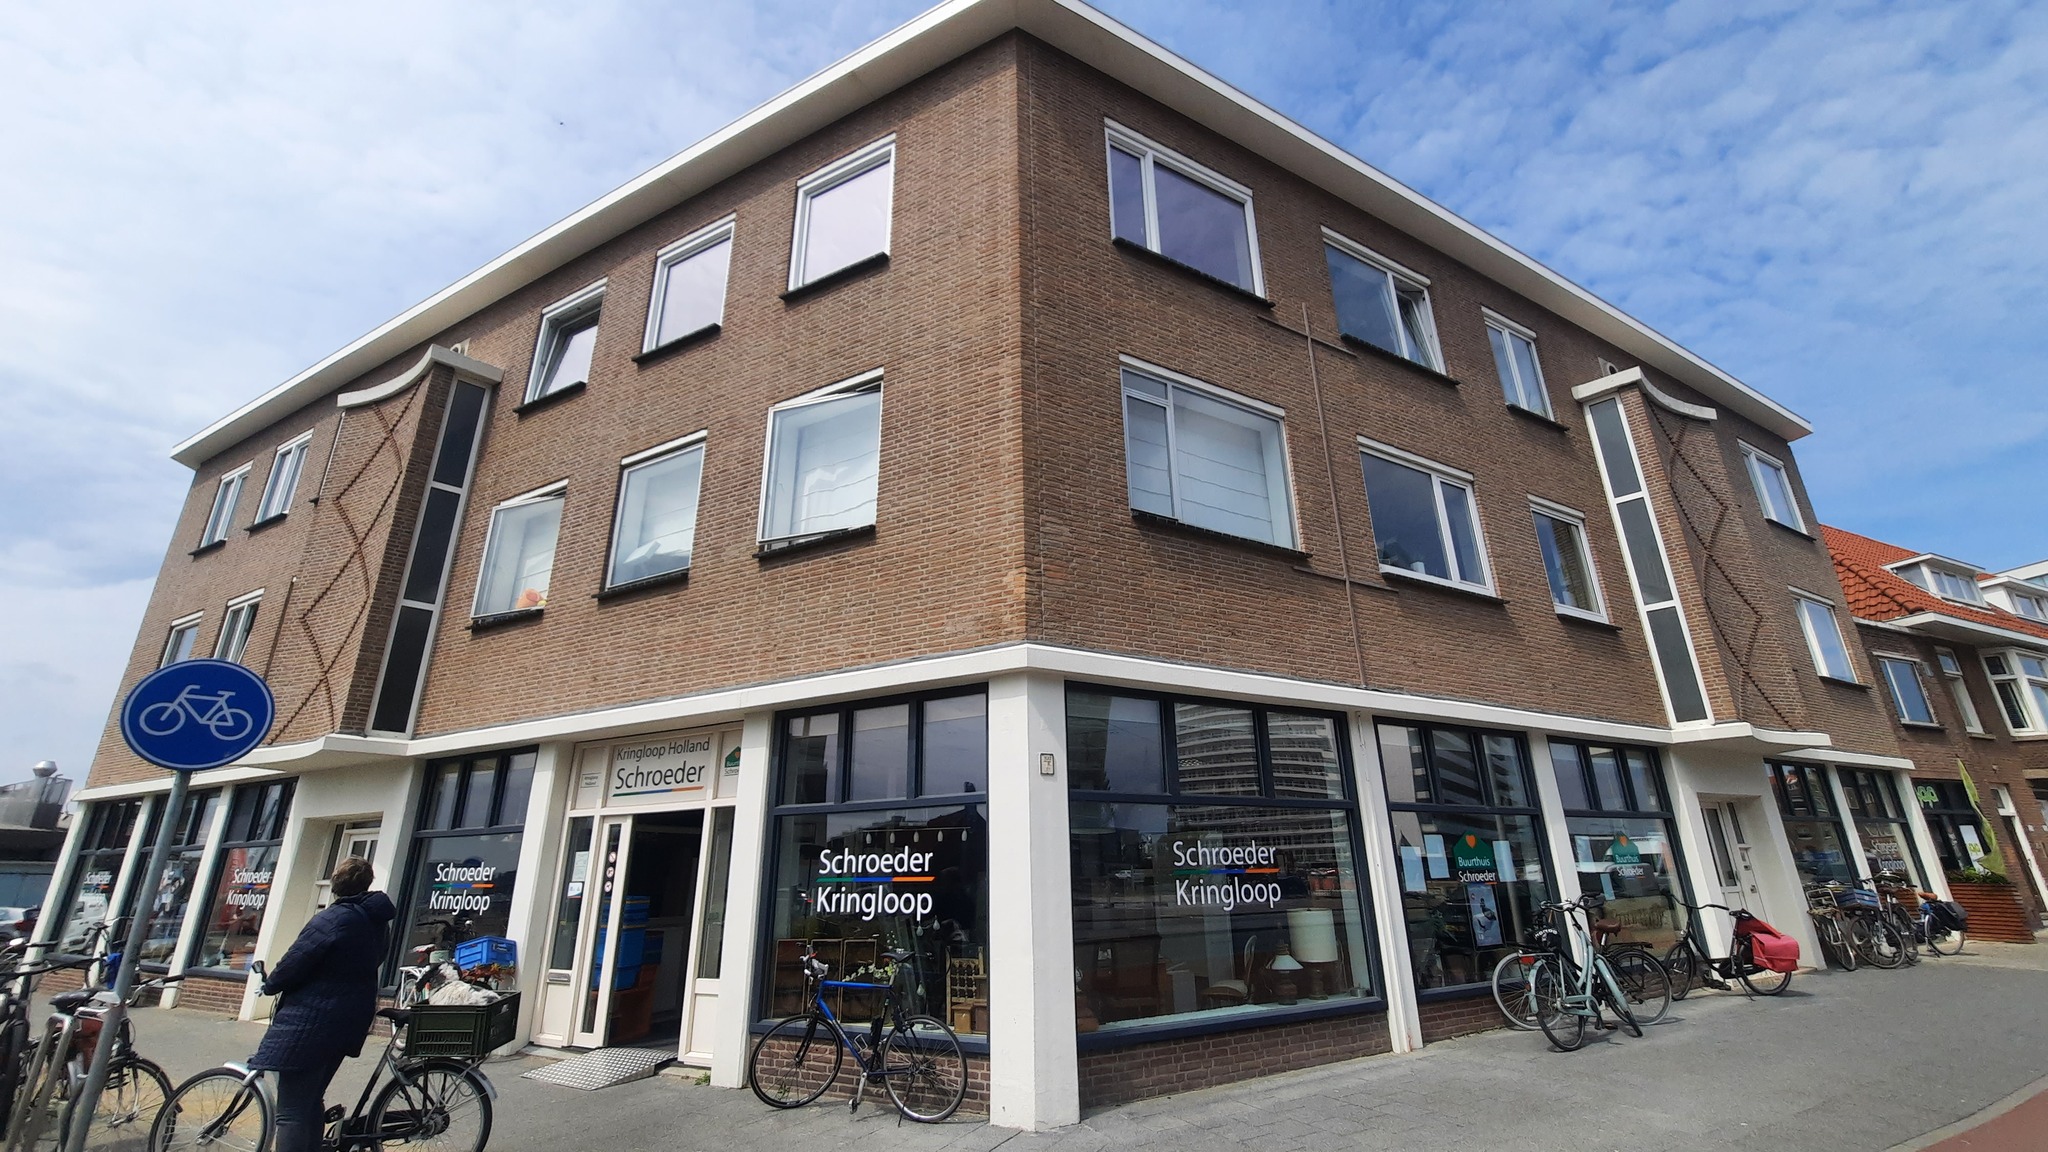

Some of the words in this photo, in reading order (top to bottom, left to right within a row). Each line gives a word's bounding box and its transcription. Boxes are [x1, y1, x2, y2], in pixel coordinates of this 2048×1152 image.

[616, 744, 666, 762] Kringloop
[667, 736, 710, 755] Holland
[614, 760, 705, 789] Schroeder
[818, 845, 934, 874] Schroeder
[1172, 839, 1276, 867] Schroeder
[1457, 856, 1491, 867] Buurthuis
[1615, 853, 1640, 864] Buurthuis
[232, 867, 272, 884] Schroeder
[434, 861, 496, 882] Schroeder
[1458, 870, 1496, 883] Schroeder
[1616, 865, 1645, 876] Schroeder
[225, 889, 266, 910] Kringloop
[429, 889, 491, 916] Kringloop
[816, 884, 933, 922] Kringloop
[1175, 876, 1282, 911] Kringloop
